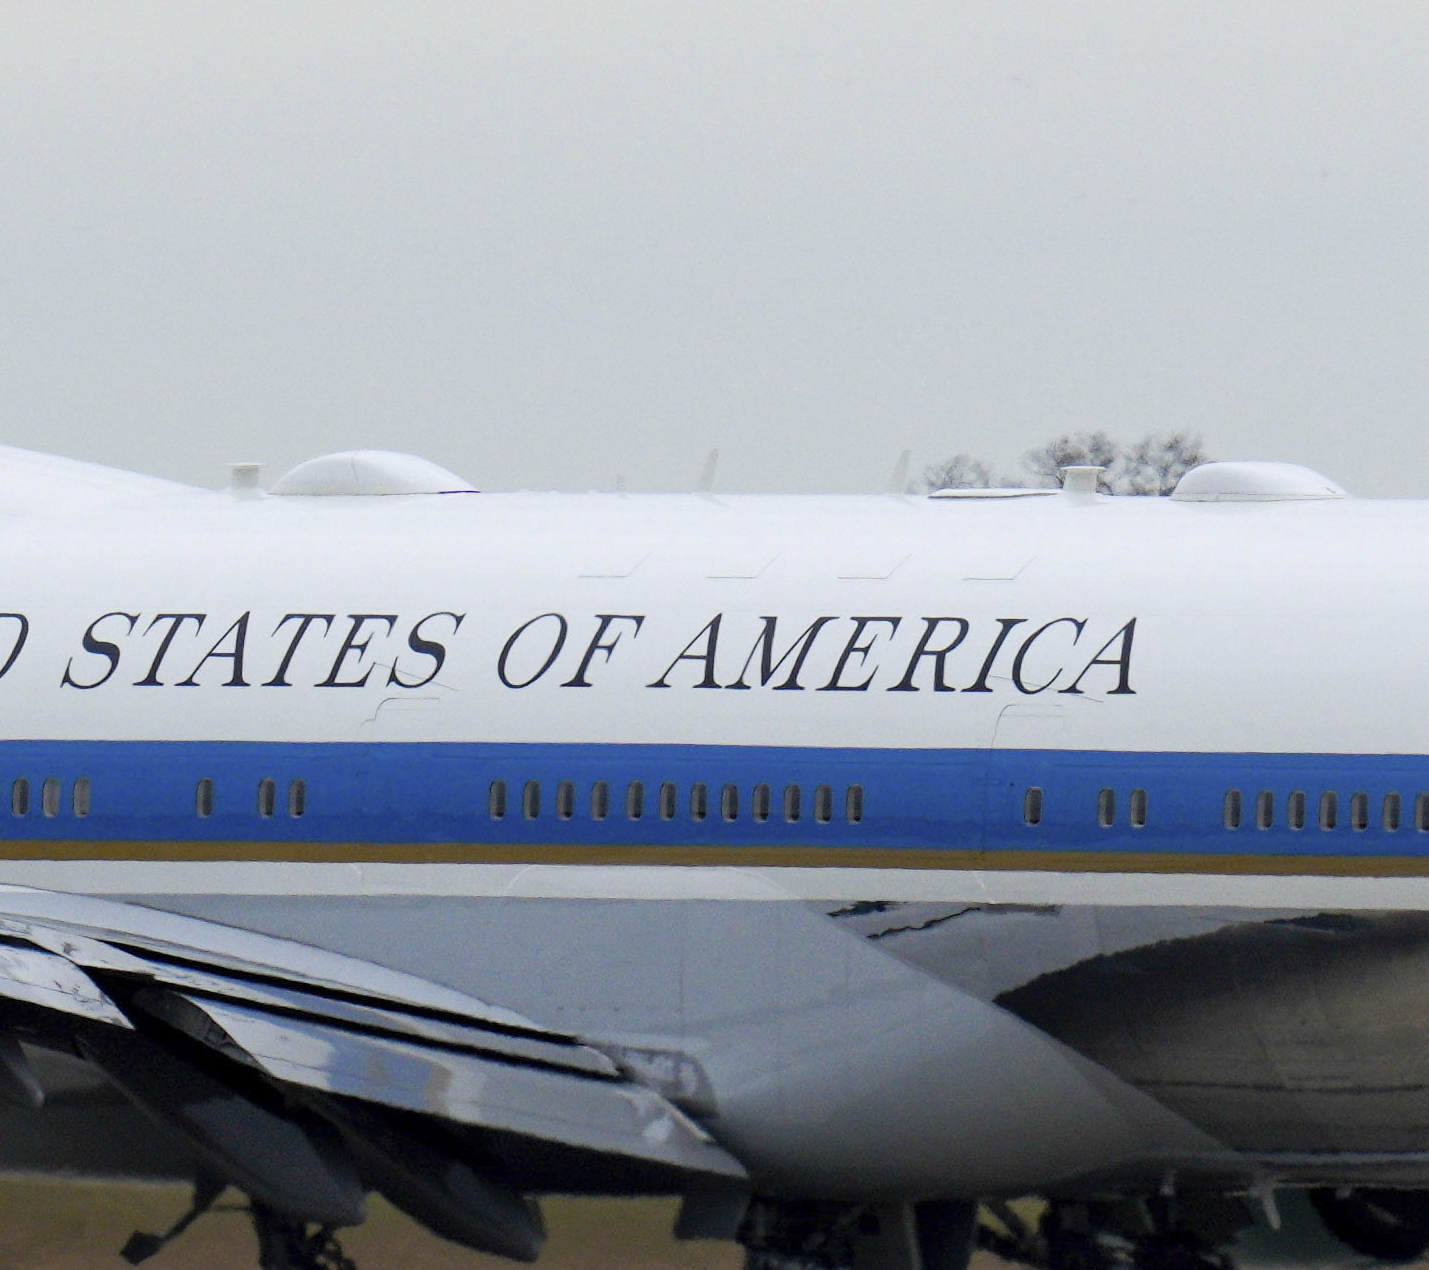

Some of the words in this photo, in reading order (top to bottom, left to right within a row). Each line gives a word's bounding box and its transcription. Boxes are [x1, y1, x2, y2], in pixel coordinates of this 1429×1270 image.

[59, 610, 466, 690] STATES
[497, 612, 646, 690] OF
[645, 612, 1137, 695] AMERICA
